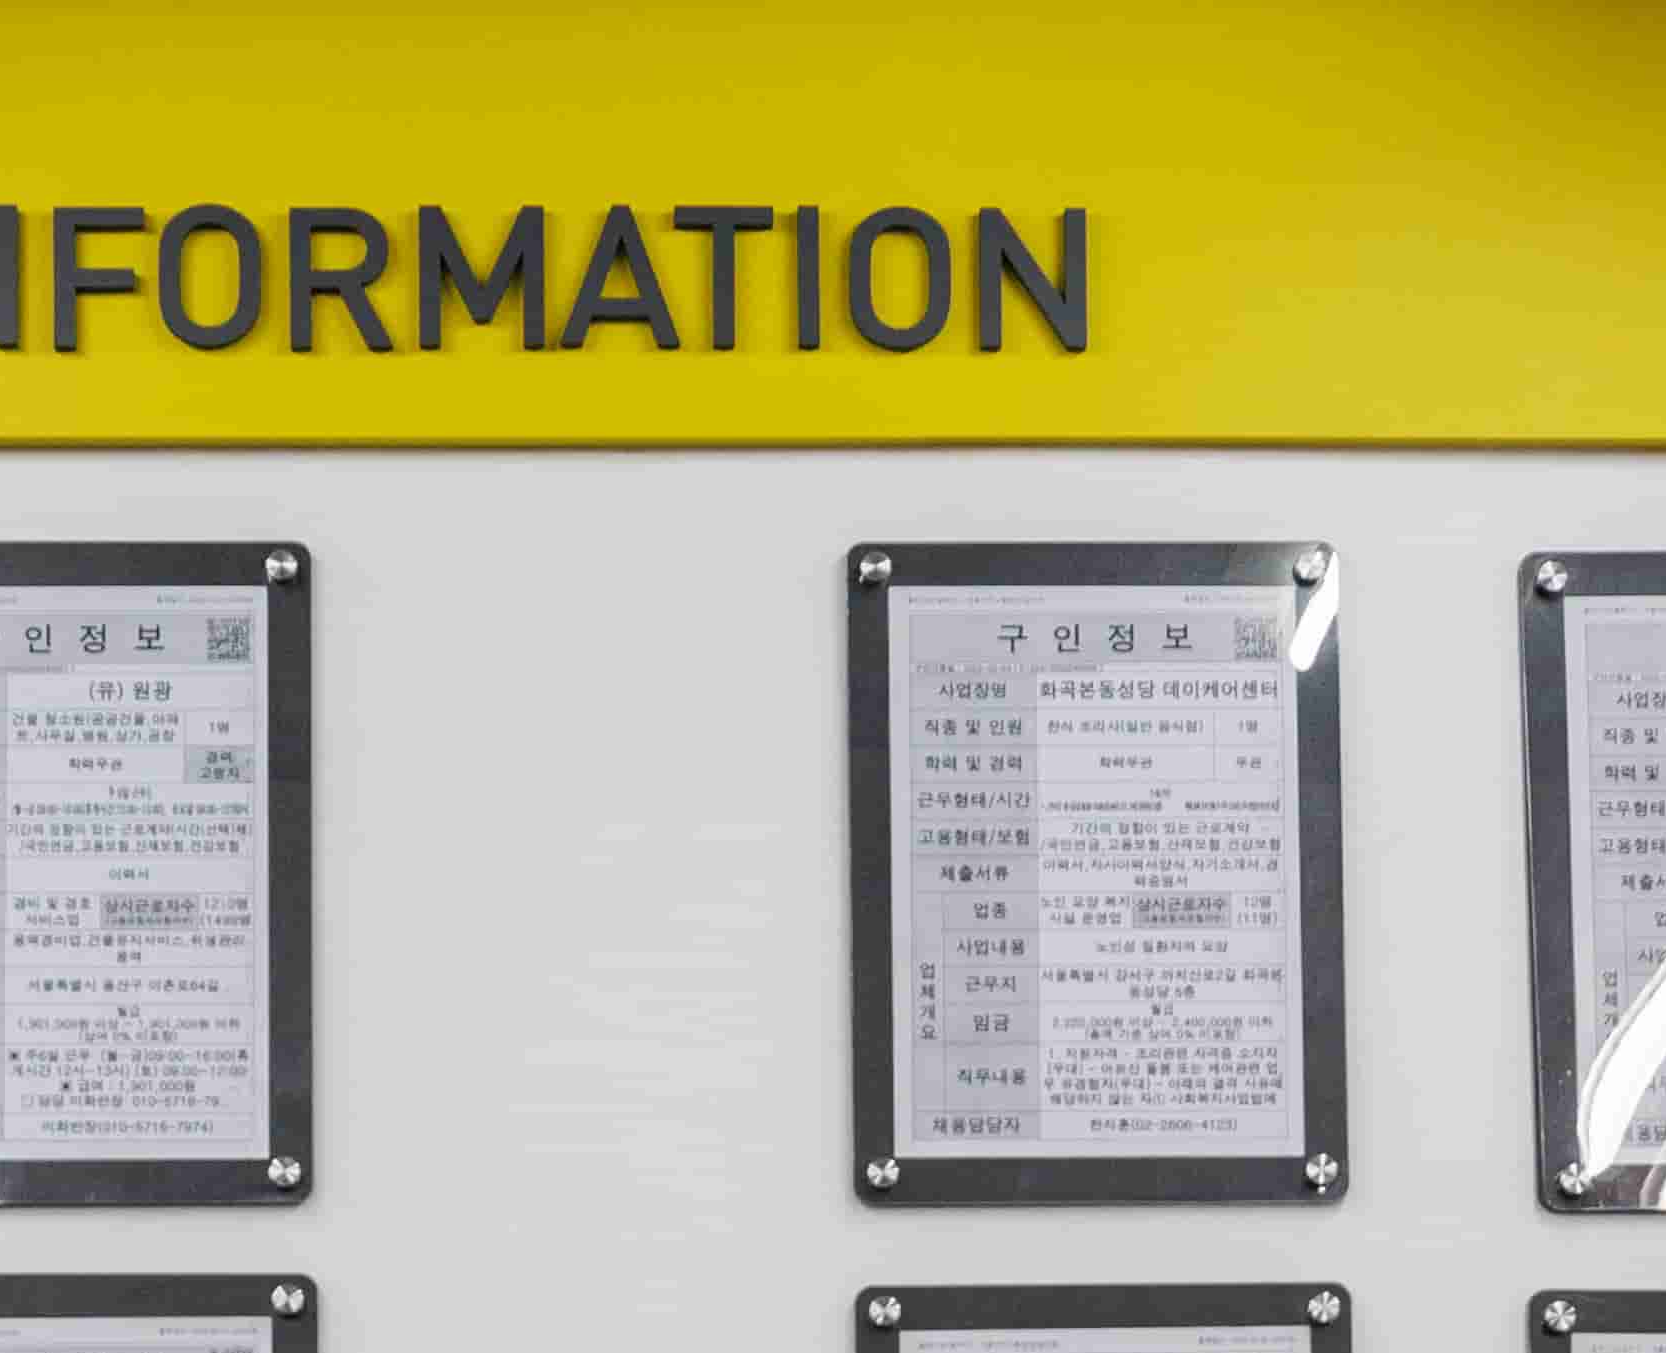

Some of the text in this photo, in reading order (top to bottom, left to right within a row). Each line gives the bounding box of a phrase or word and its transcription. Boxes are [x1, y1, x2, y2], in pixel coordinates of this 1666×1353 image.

[88, 679, 174, 703] (유) 원광
[938, 679, 1006, 701] 사업장명
[1040, 679, 1278, 701] 화곡본동성당 데이케어센터
[916, 791, 1031, 810] 근무형태/시간
[917, 828, 1030, 847] 고용형태/보험
